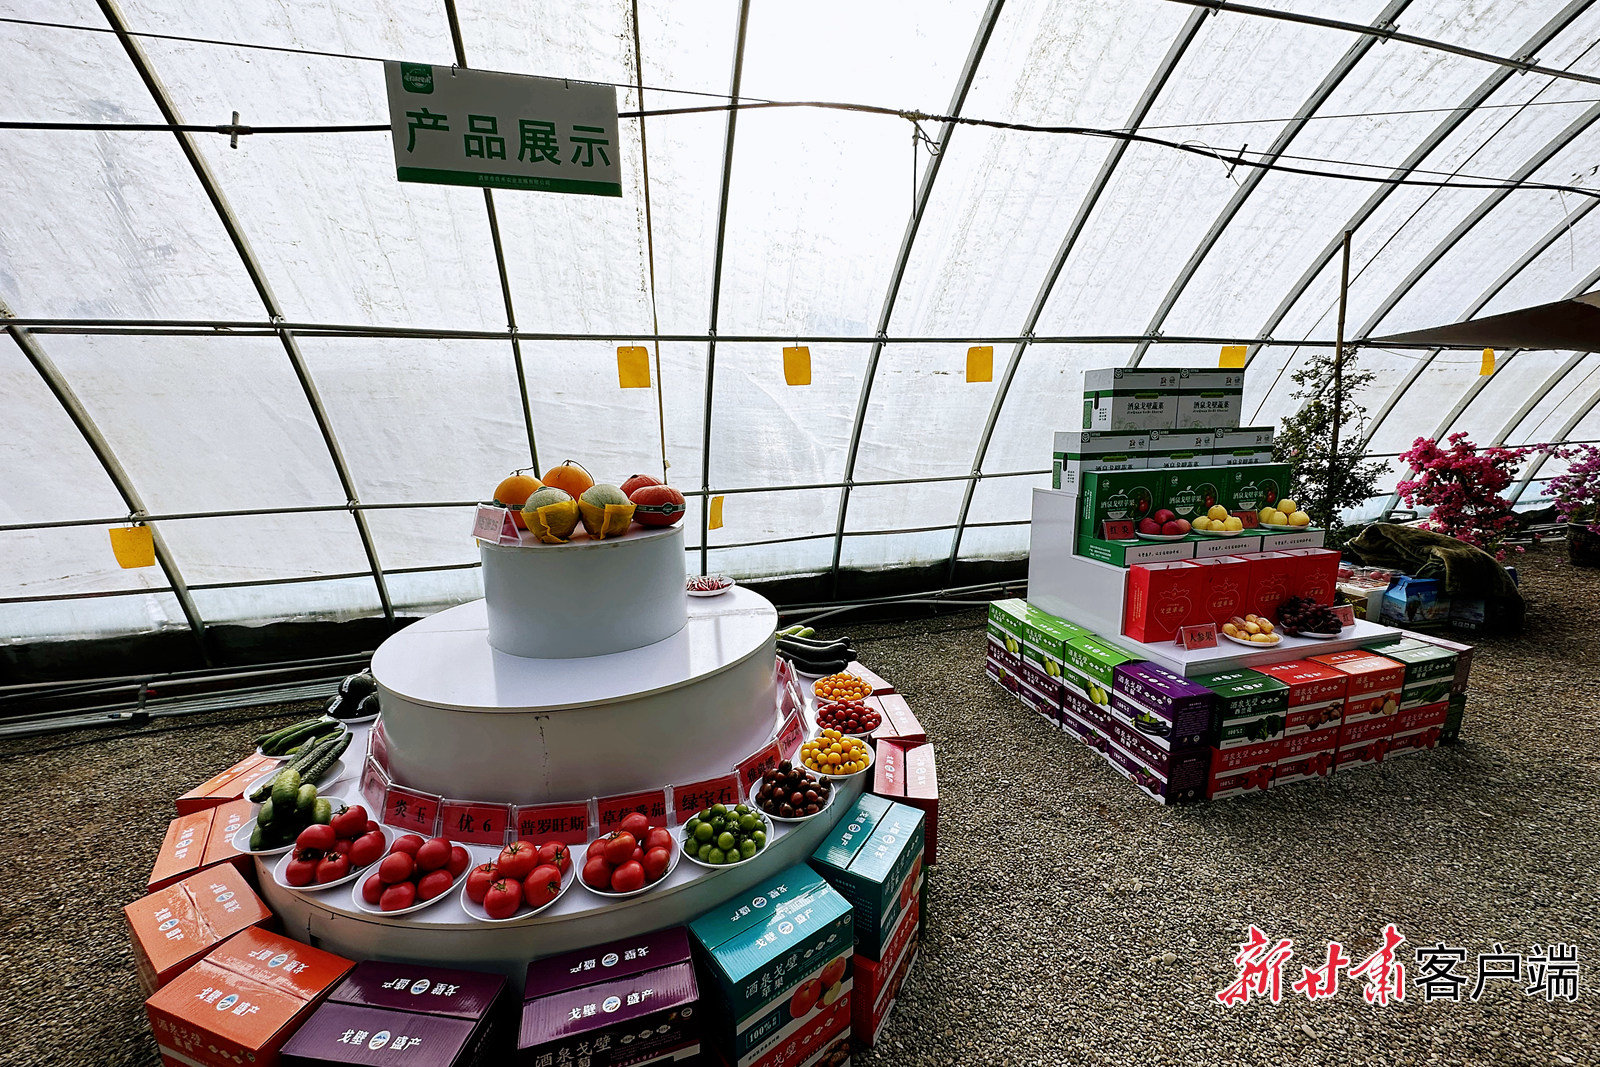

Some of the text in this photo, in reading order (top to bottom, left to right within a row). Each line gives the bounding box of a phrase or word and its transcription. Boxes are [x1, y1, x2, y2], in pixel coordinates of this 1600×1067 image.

[406, 107, 611, 167] 产品展示
[1189, 631, 1214, 642] 人参果
[682, 786, 732, 811] 绿宝石
[394, 799, 427, 824] 炎玉
[520, 815, 585, 836] 普罗旺斯
[745, 953, 798, 999] 酒泉戈壁
[761, 976, 784, 998] 苹果
[567, 988, 654, 1021] 戈壁 盛产
[336, 1028, 422, 1051] 戈壁 盛产
[749, 1020, 772, 1043] 100%
[535, 1034, 612, 1067] 酒泉戈壁
